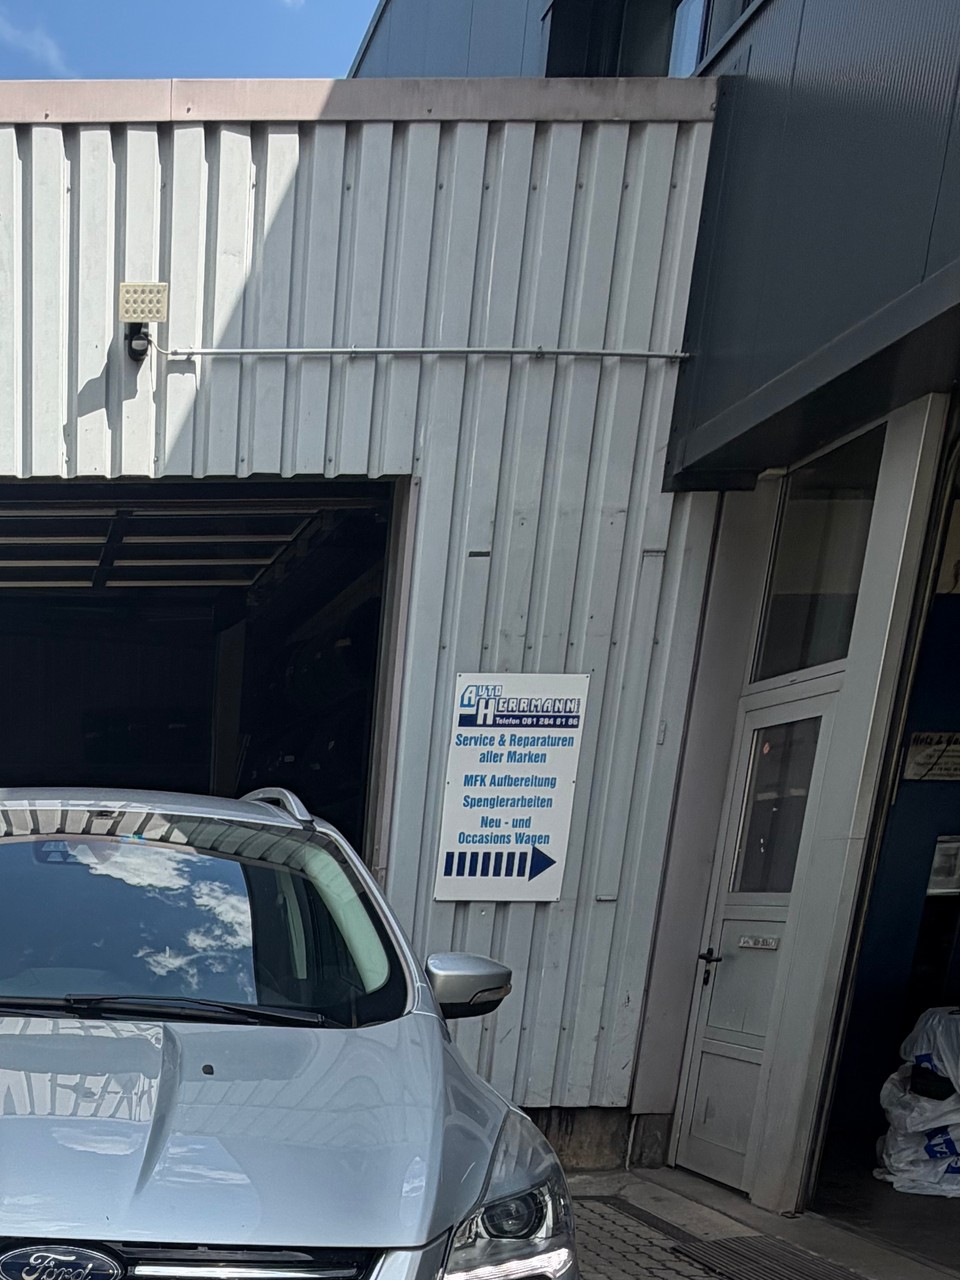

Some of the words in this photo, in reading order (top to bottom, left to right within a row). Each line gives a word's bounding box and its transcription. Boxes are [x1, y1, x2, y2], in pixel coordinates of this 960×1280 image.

[460, 685, 502, 708] AUTO
[476, 698, 576, 725] HERRMANN
[455, 734, 495, 747] Service
[498, 734, 506, 747] &
[509, 734, 574, 748] Reparaturen
[479, 751, 503, 763] aller
[507, 751, 546, 763] Marken
[463, 775, 486, 787] MFK
[489, 775, 557, 789] Aufbereitung
[463, 795, 552, 810] Spenglerarbeiten
[481, 816, 501, 828] Neu
[512, 816, 531, 828] und
[458, 832, 511, 844] Occasions
[515, 833, 550, 846] Wagen
